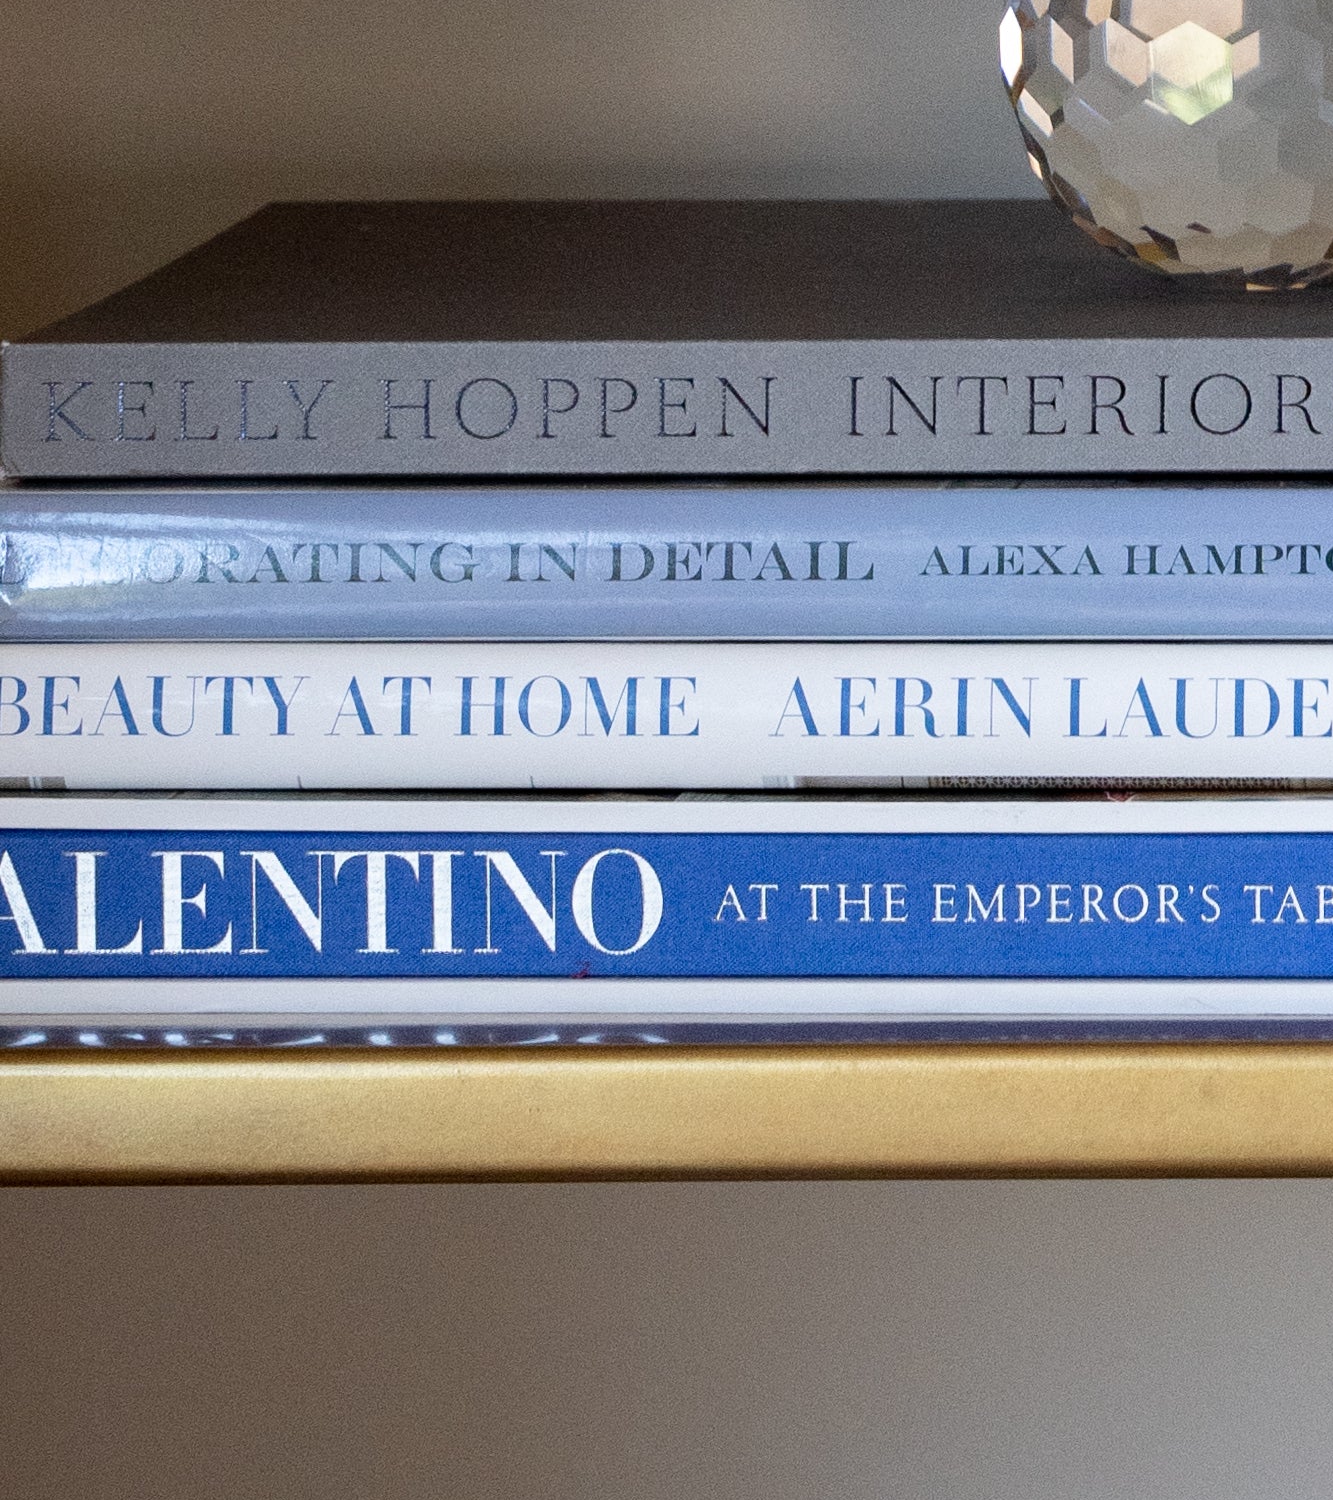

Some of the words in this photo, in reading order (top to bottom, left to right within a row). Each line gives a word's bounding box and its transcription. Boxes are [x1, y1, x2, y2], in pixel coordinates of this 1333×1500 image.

[41, 378, 336, 443] KELLY
[376, 376, 779, 441] HOPPEN
[499, 541, 597, 584] IN
[607, 540, 875, 583] DETAIL
[918, 542, 1104, 577] ALEXA
[0, 674, 312, 737] BEAUTY
[330, 674, 436, 737] AT
[453, 674, 702, 737] HOME
[769, 675, 1041, 741] AERIN
[714, 882, 779, 924] AT
[800, 882, 909, 924] THE
[931, 882, 1222, 926] EMPEROR'S
